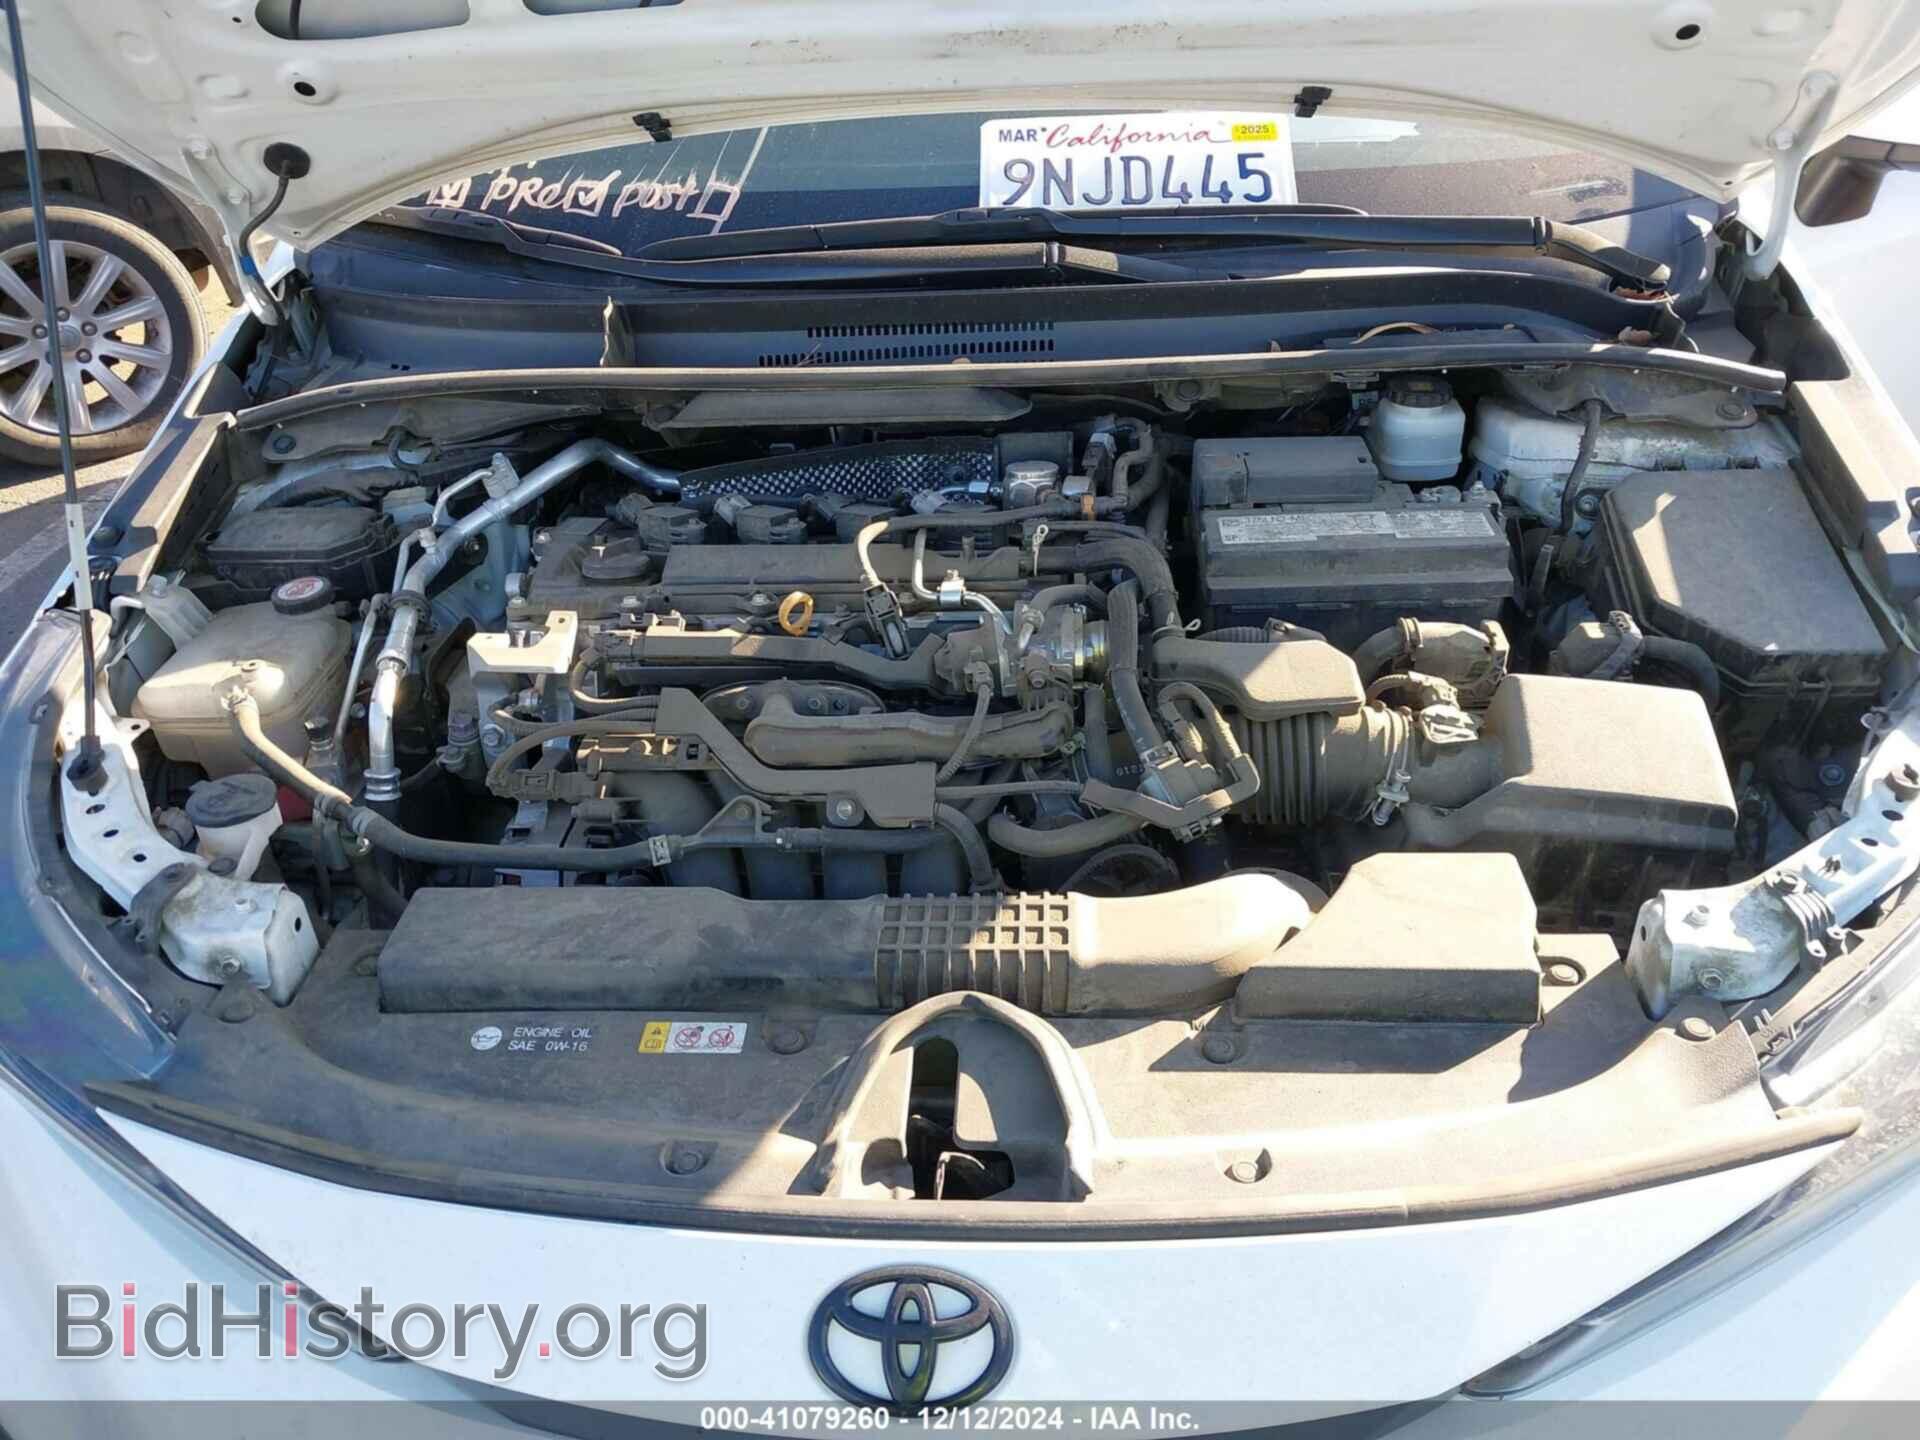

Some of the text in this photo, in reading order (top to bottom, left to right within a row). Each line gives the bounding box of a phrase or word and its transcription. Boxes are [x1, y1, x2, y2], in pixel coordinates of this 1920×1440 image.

[1240, 124, 1270, 135] 2025
[999, 123, 1233, 153] MAR California
[1001, 152, 1273, 206] 9NJD445
[513, 1027, 593, 1038] ENGINE OIL
[508, 1040, 588, 1051] SAE 0W-16
